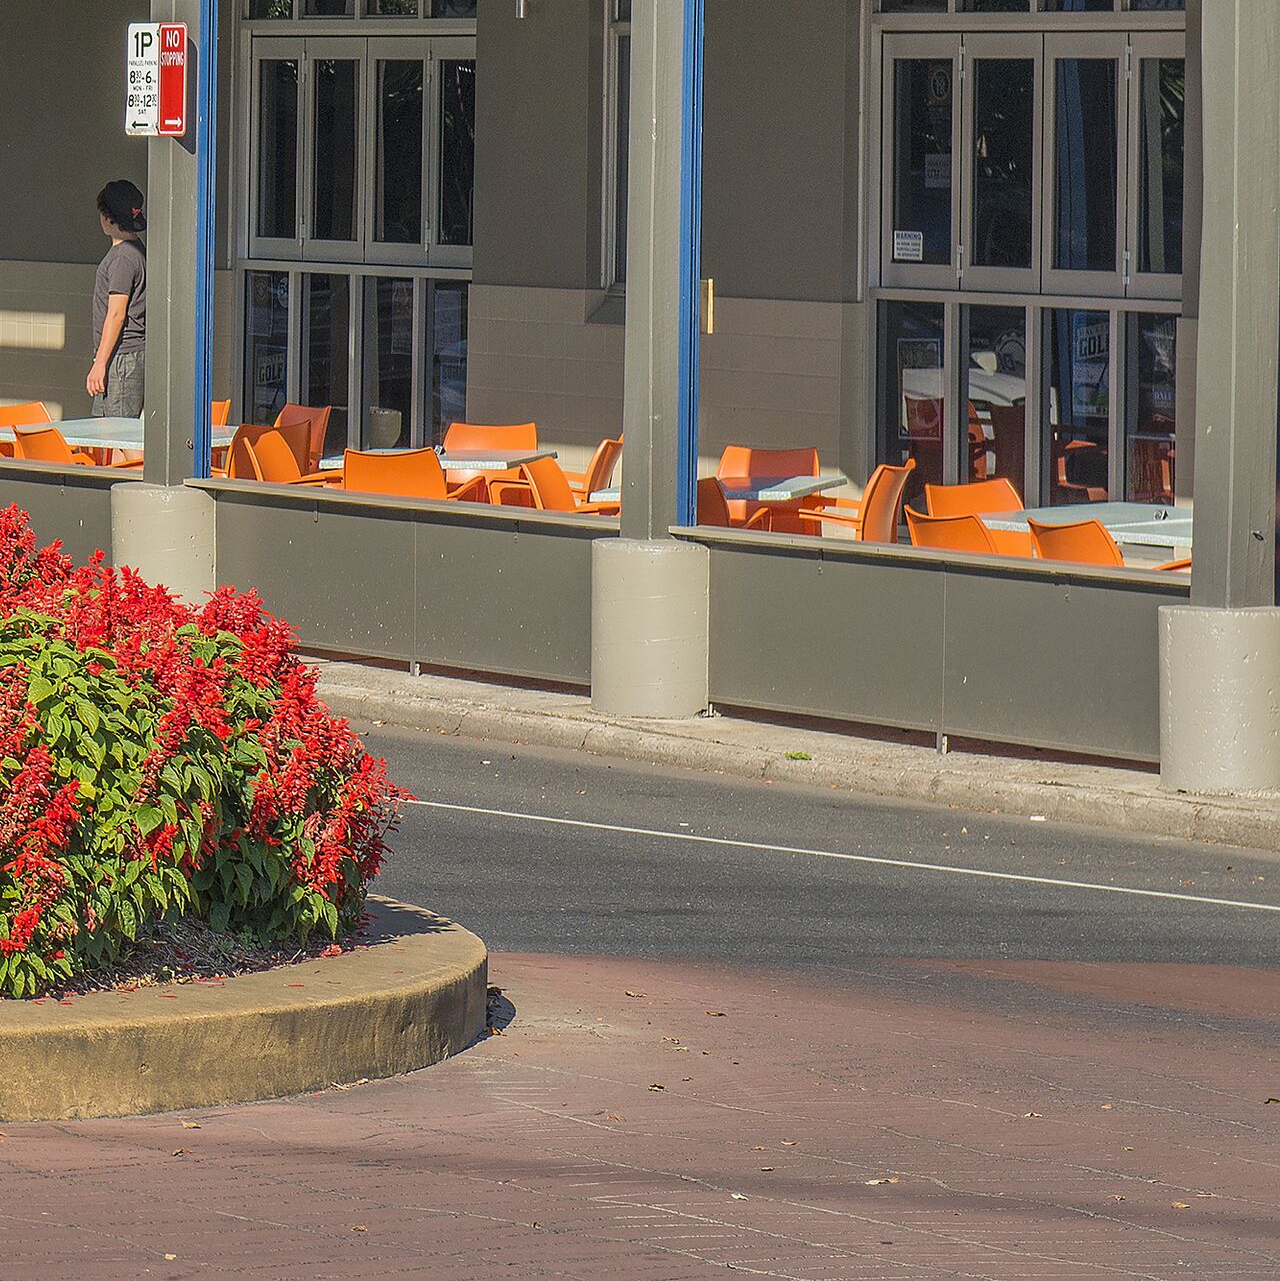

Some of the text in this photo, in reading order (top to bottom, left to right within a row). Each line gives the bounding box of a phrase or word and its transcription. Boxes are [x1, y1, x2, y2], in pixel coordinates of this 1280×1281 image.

[134, 31, 153, 57] 1P
[166, 29, 180, 48] NO
[161, 51, 184, 66] STOPPING
